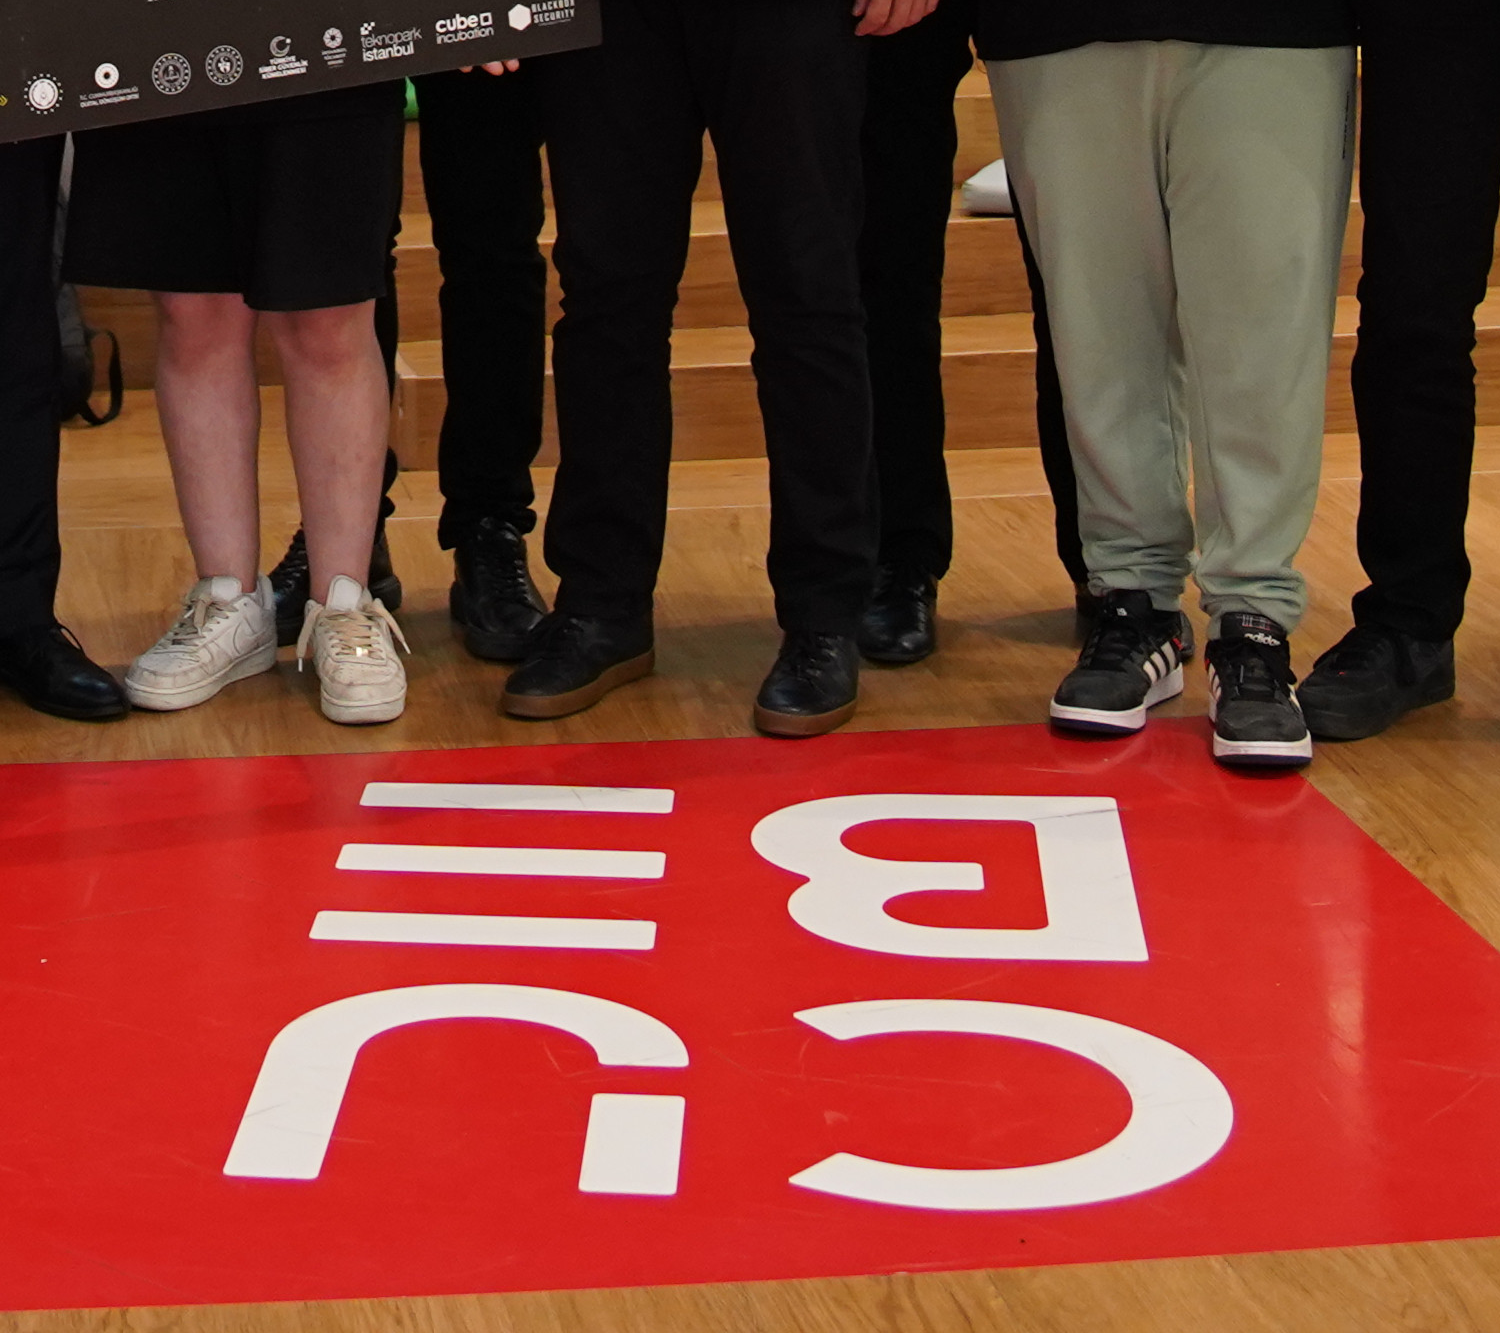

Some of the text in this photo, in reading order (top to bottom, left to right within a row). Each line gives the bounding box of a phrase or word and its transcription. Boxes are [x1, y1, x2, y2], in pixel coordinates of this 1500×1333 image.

[435, 14, 478, 33] cube
[533, 8, 575, 23] SECURITY
[361, 28, 422, 49] teknopark
[436, 25, 495, 45] incubation
[362, 41, 414, 62] istanbul
